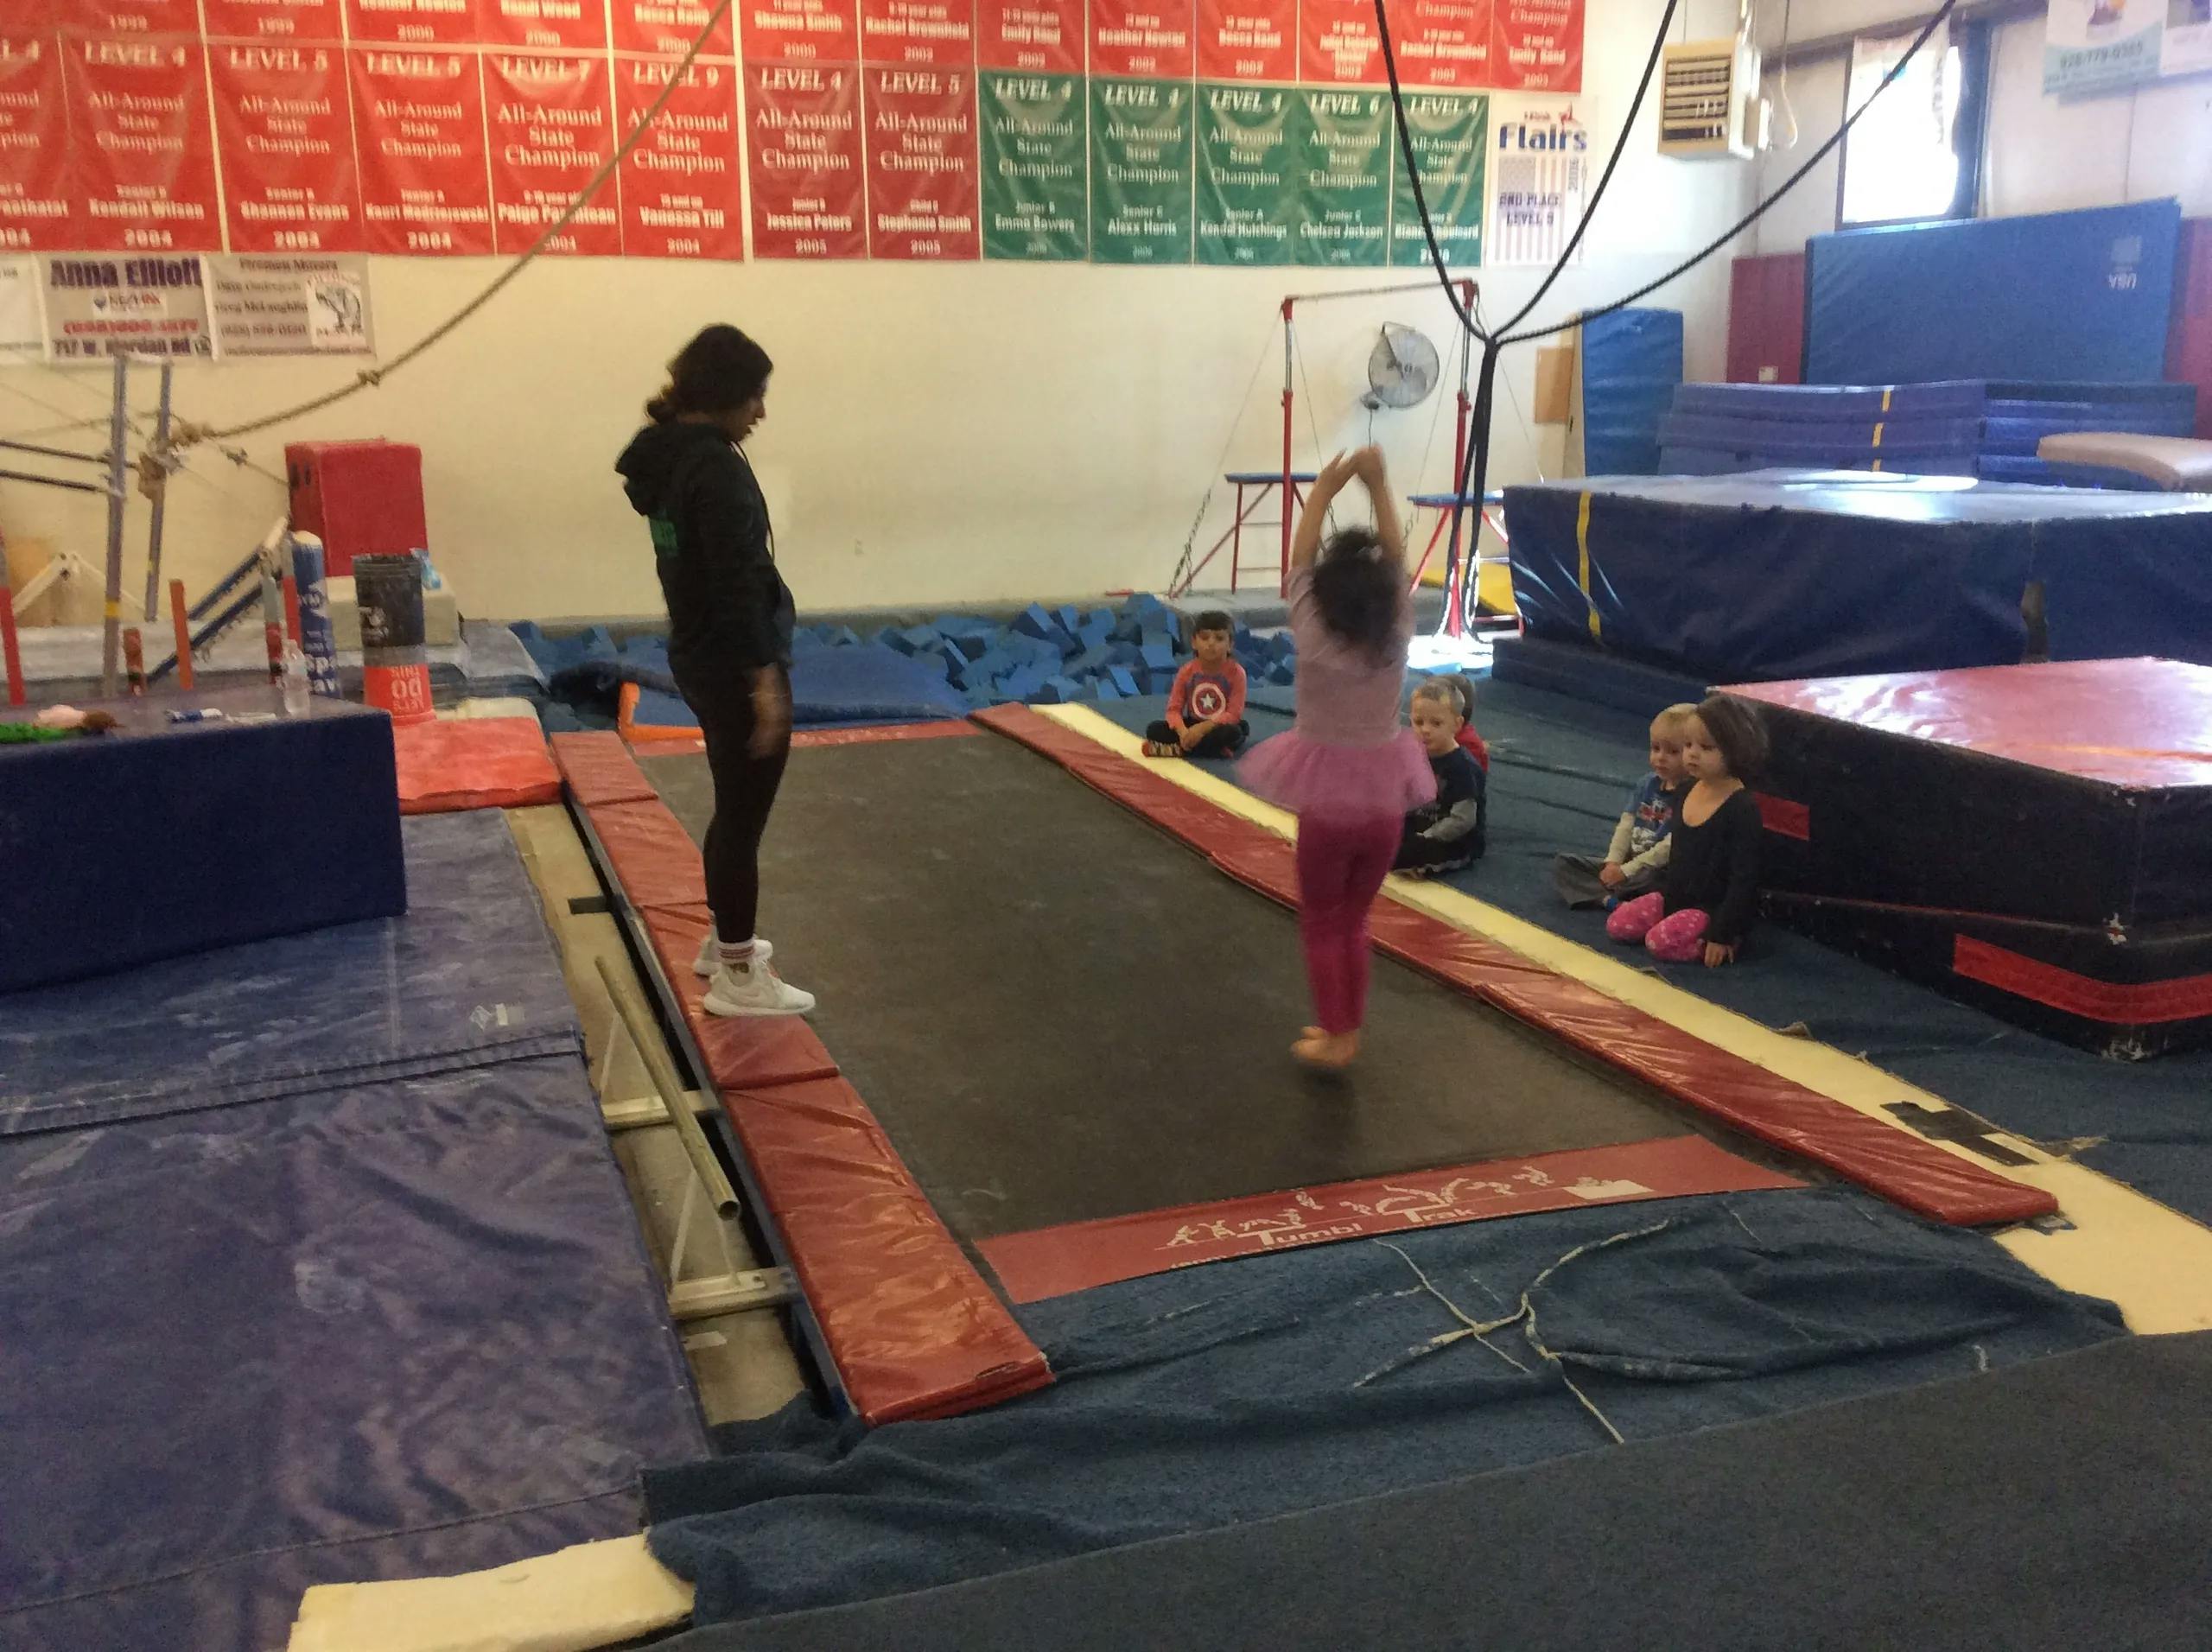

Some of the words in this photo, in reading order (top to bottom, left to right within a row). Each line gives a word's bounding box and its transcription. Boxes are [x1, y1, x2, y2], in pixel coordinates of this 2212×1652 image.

[85, 41, 165, 67] LEVEL
[230, 48, 308, 71] LEVEL
[367, 52, 442, 78] LEVEL
[503, 56, 574, 83] LEVEL
[761, 67, 825, 92] LEVEL
[830, 71, 842, 92] 4
[880, 71, 943, 96] LEVEL
[995, 78, 1052, 102] LEVEL
[1105, 84, 1159, 107] LEVEL
[1211, 90, 1263, 113] LEVEL
[1310, 94, 1361, 116] LEVEL
[1410, 96, 1463, 117] LEVEL
[756, 108, 853, 131] All-Around
[875, 111, 968, 135] All-Around
[95, 130, 183, 156] Champion
[245, 134, 330, 158] Champion
[380, 138, 462, 162] Champion
[504, 143, 601, 173] Champion
[632, 148, 726, 177] Champion
[761, 149, 850, 175] Champion
[880, 150, 964, 177] Champion
[999, 157, 1073, 182] Champion
[1107, 163, 1179, 187] Champion
[1212, 167, 1281, 190] Champion
[1309, 169, 1377, 191] Champion
[1417, 170, 1469, 187] hampion
[995, 213, 1032, 232] Emma
[51, 259, 119, 289] Anna
[391, 677, 423, 701] DO
[1237, 1223, 1363, 1246] Tumbl
